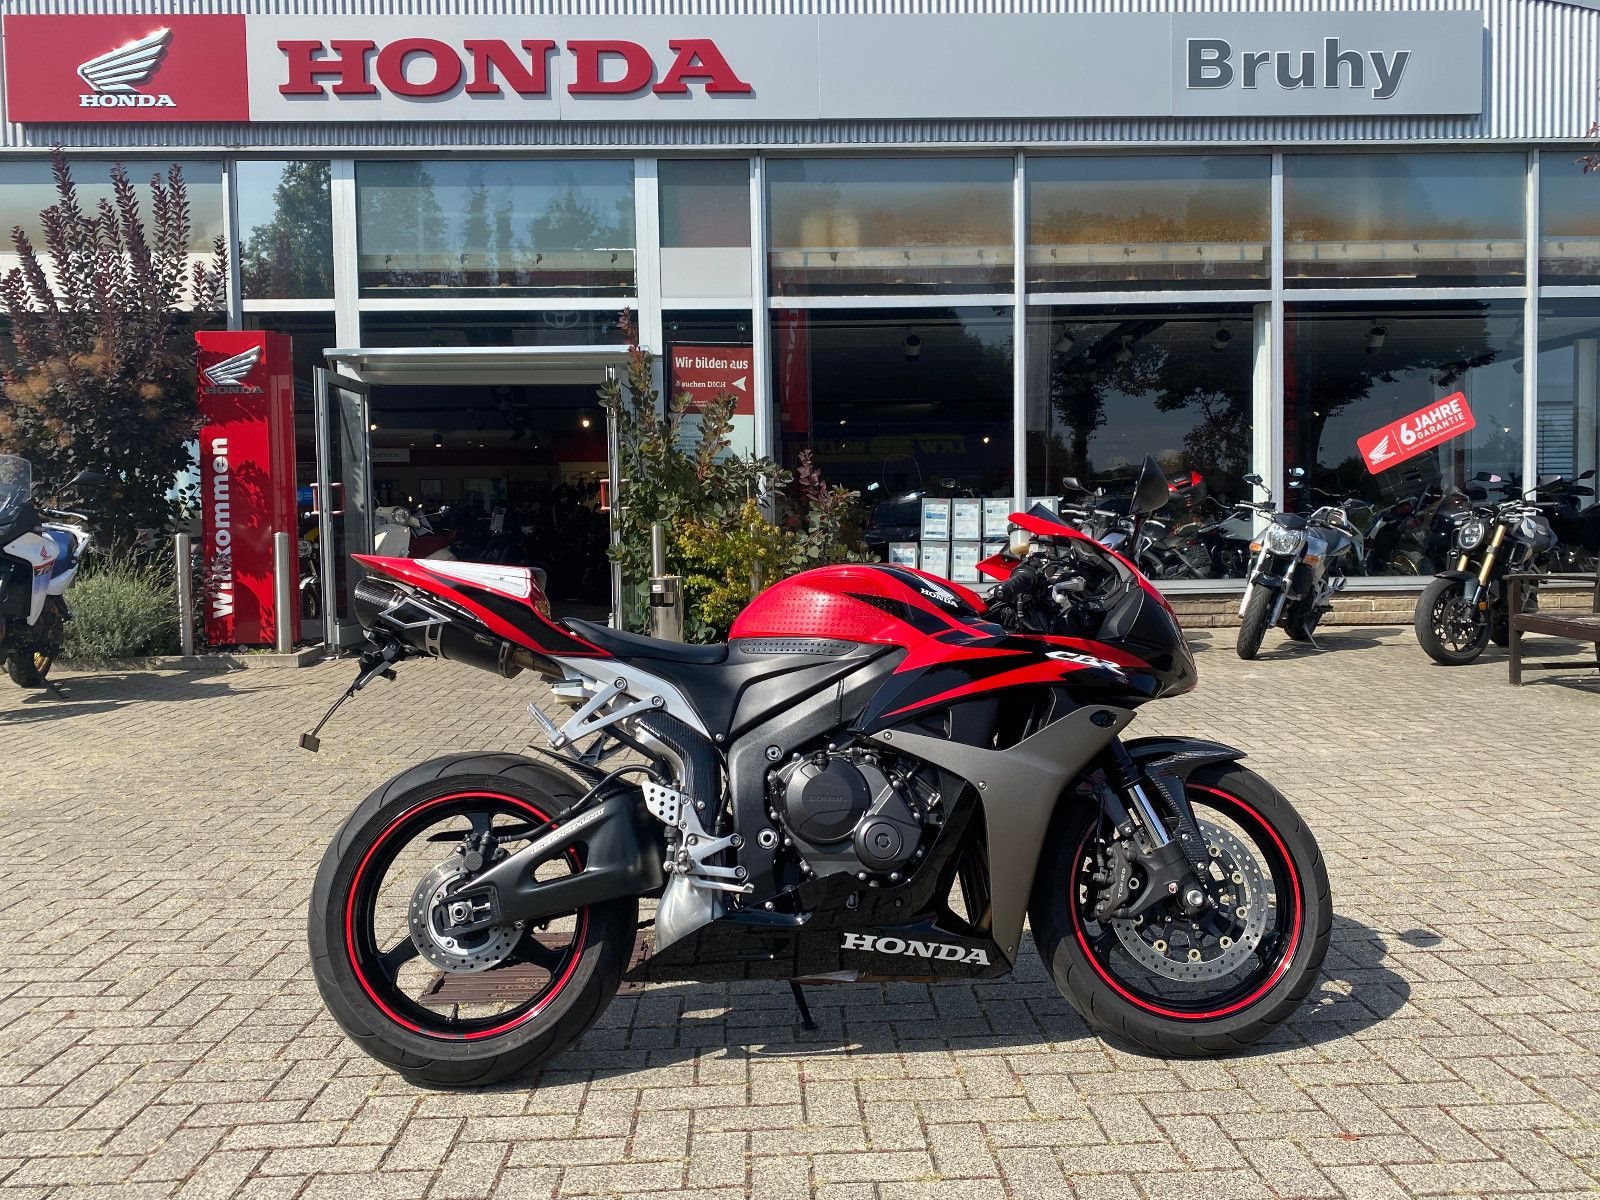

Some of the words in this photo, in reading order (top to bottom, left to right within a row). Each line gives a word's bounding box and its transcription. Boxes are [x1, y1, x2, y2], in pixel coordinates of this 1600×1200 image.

[277, 37, 751, 97] HONDA
[1186, 36, 1412, 99] Bruhy
[79, 94, 176, 107] HONDA
[675, 356, 693, 369] Wir
[695, 357, 727, 369] bilden
[730, 359, 748, 369] aus
[205, 386, 265, 394] HONDA
[681, 380, 706, 388] suchen
[707, 380, 726, 388] DICH
[1400, 422, 1417, 445] 6
[1416, 412, 1465, 439] GARANTIE
[211, 437, 233, 619] Wilkommen
[920, 587, 959, 608] HONDA
[1045, 651, 1126, 677] CBR
[841, 932, 991, 966] HONDA
